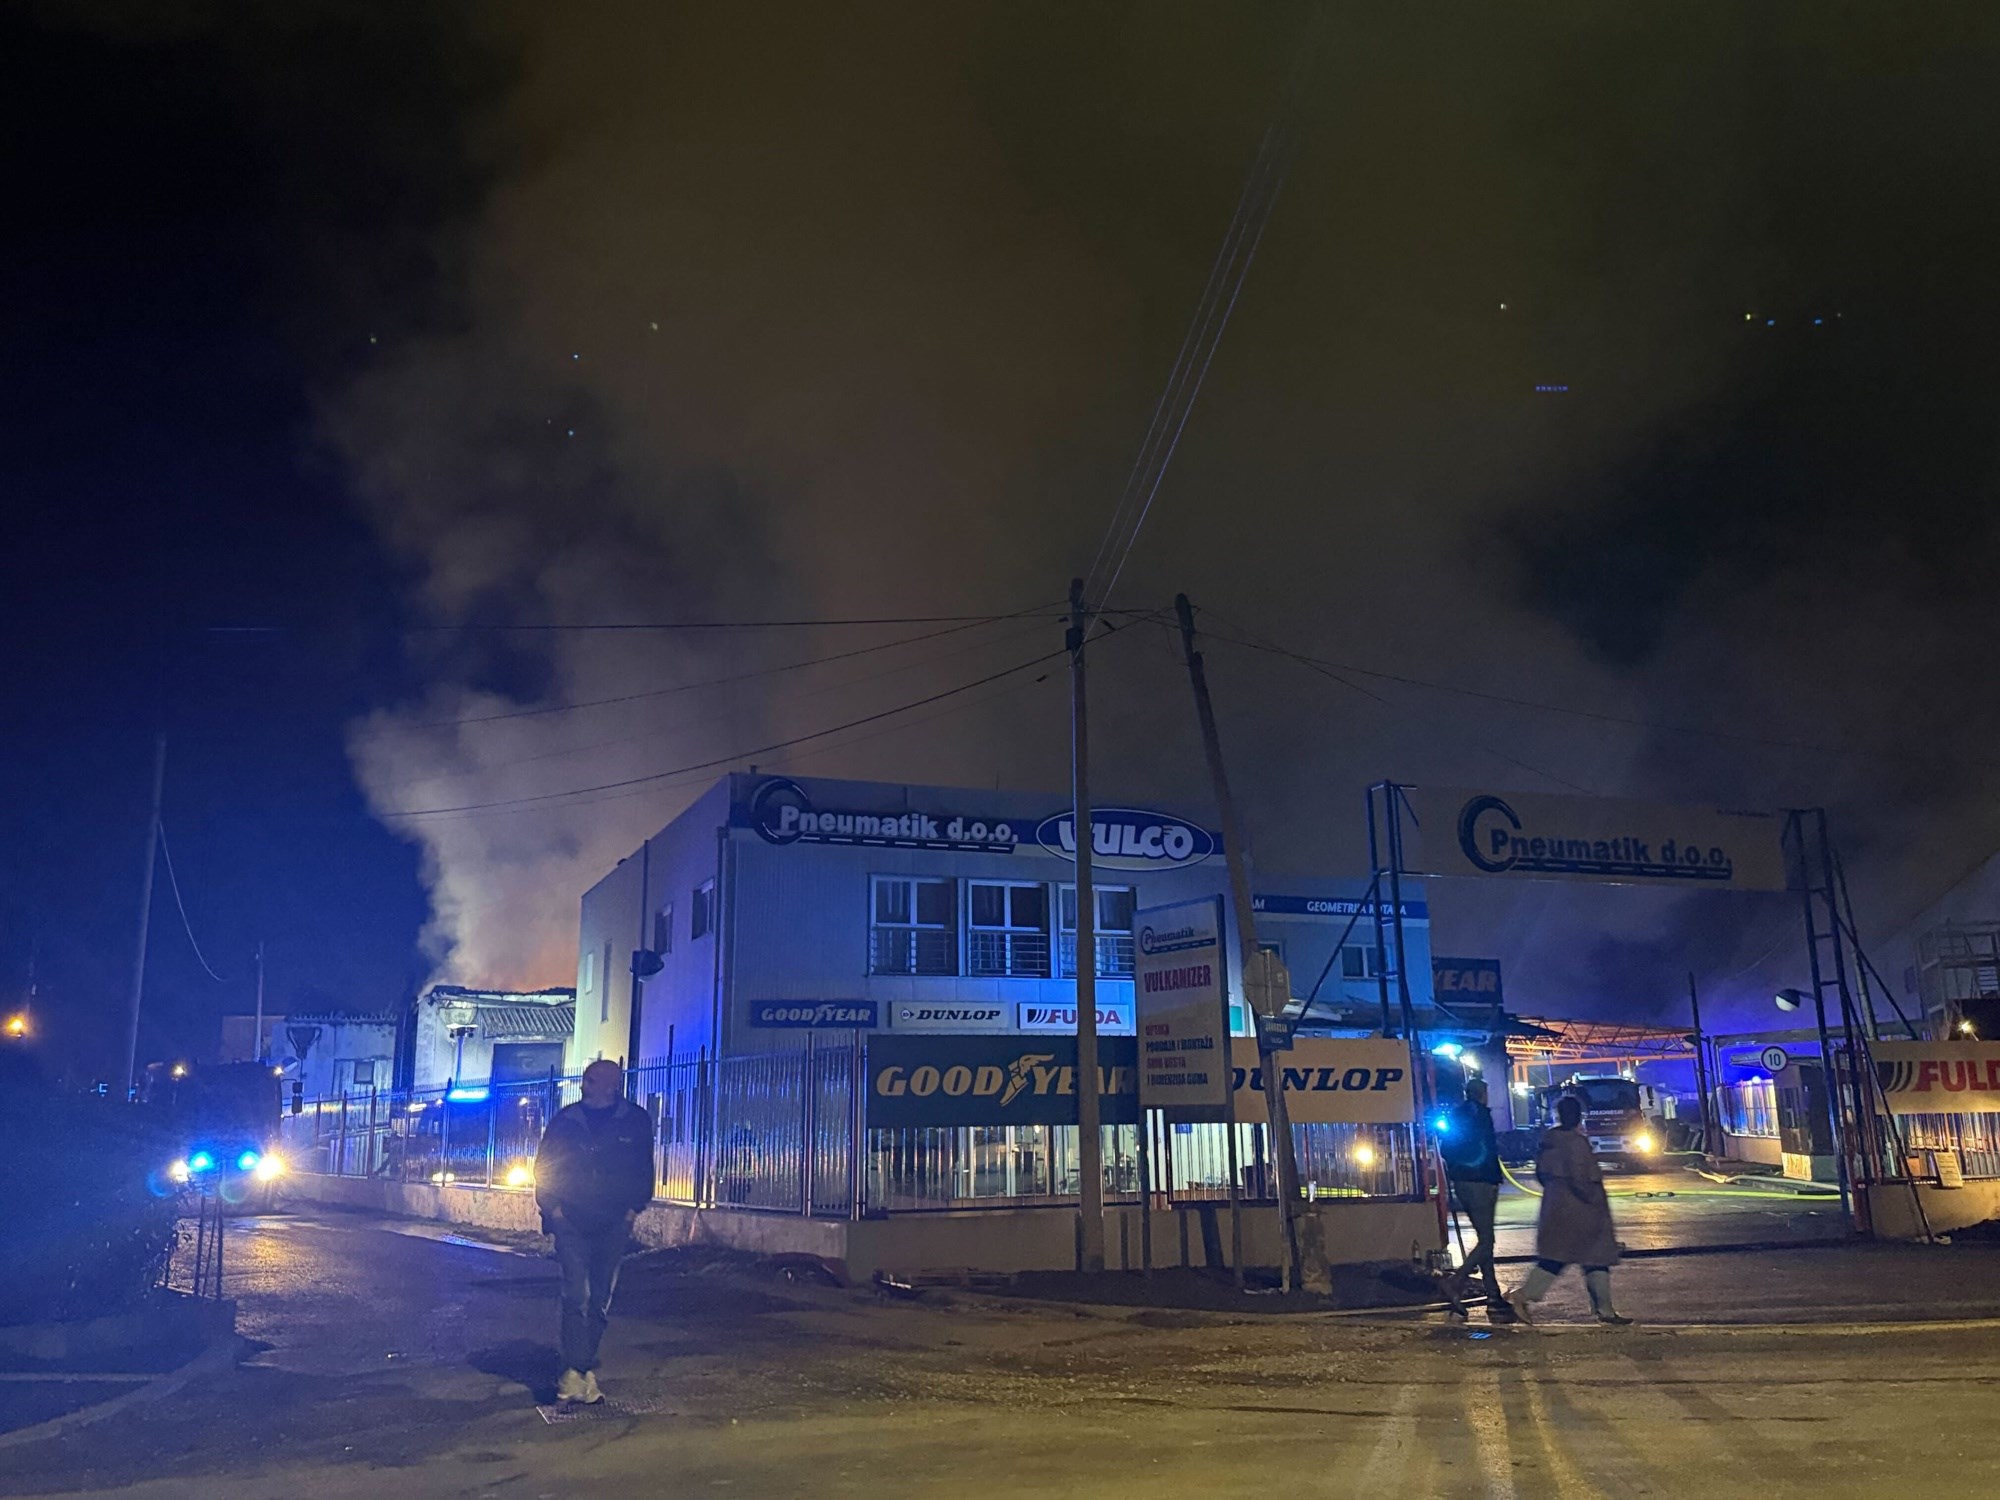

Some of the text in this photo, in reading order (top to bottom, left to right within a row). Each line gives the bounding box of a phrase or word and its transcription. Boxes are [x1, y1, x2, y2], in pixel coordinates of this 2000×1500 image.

[780, 805, 1019, 842] Pneumatik d.o.o.
[1490, 829, 1732, 866] Pneumatik d.o.o.
[1144, 965, 1211, 993] VULKANIZER
[917, 1009, 1000, 1021] DUNLOP
[1045, 1009, 1121, 1024] FUDA
[1769, 1053, 1781, 1066] 10
